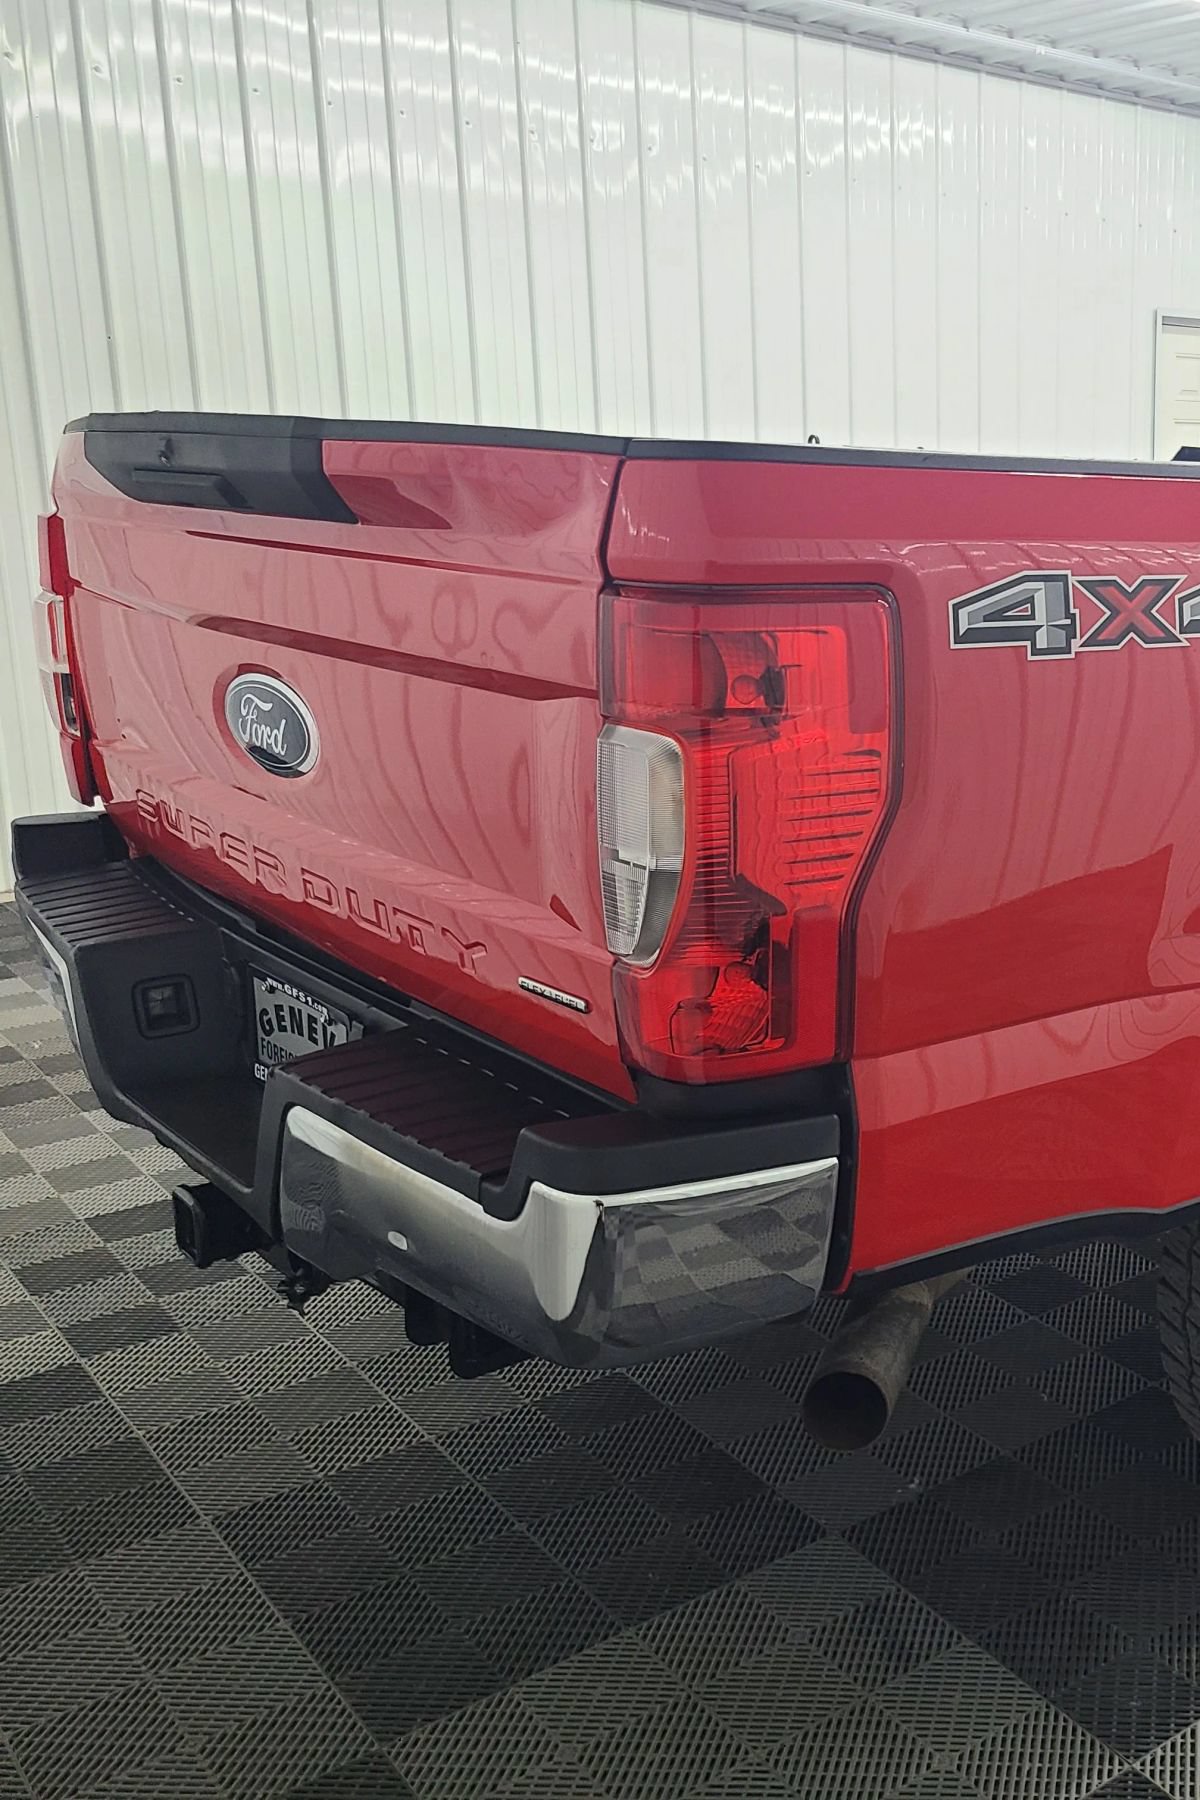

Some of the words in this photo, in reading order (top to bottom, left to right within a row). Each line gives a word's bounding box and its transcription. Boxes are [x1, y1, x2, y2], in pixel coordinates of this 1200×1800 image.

[239, 693, 287, 756] Ford
[135, 788, 289, 893] SUPER
[301, 865, 488, 976] DUTY
[259, 1004, 336, 1049] GENEV
